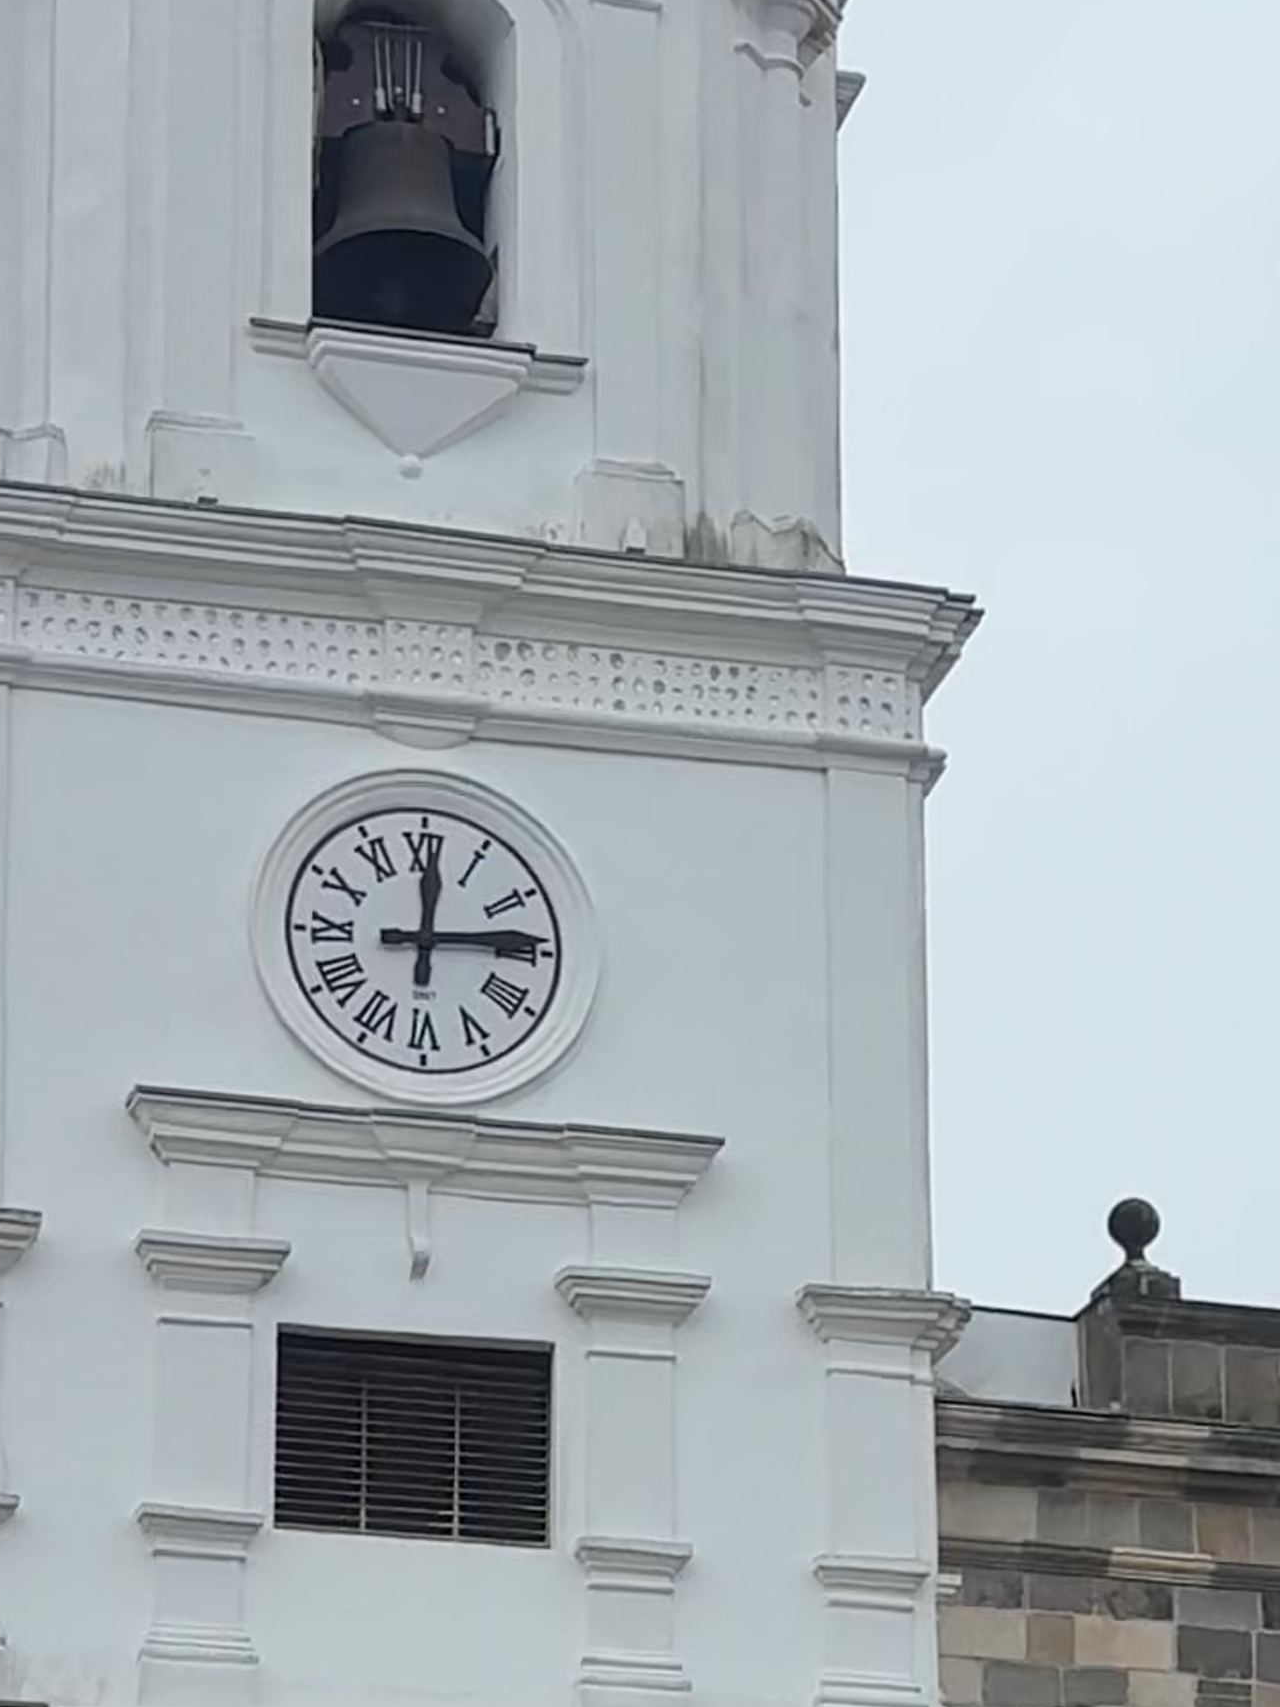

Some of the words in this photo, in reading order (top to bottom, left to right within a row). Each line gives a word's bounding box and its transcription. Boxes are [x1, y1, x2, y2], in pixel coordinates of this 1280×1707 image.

[354, 836, 398, 883] XI
[457, 850, 486, 887] I
[321, 867, 368, 907] X
[483, 888, 526, 919] II
[311, 910, 354, 944] IX
[315, 952, 368, 1008] VIII
[353, 990, 398, 1042] VII
[407, 1008, 440, 1051] VI
[458, 1005, 491, 1045] V
